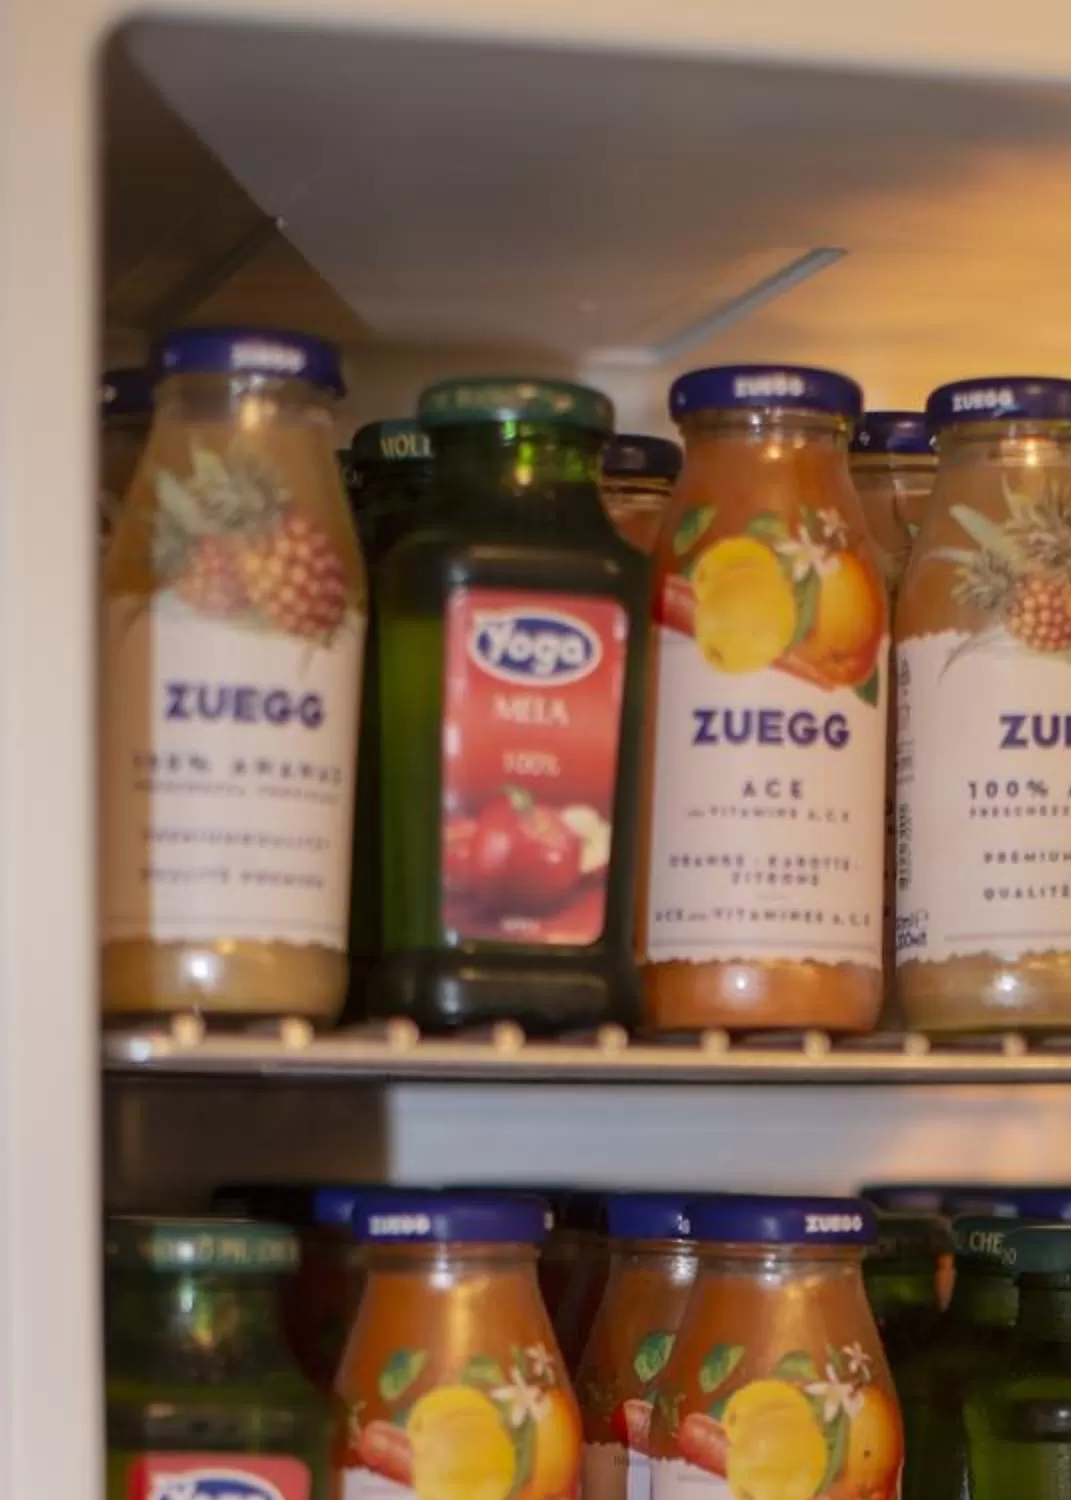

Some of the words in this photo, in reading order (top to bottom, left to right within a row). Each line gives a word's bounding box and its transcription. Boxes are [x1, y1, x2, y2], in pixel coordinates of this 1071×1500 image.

[482, 610, 588, 678] Yoga
[164, 682, 325, 730] ZUEGG
[692, 708, 851, 749] ZUEGG
[742, 778, 803, 799] ACE
[967, 779, 1049, 799] 100%
